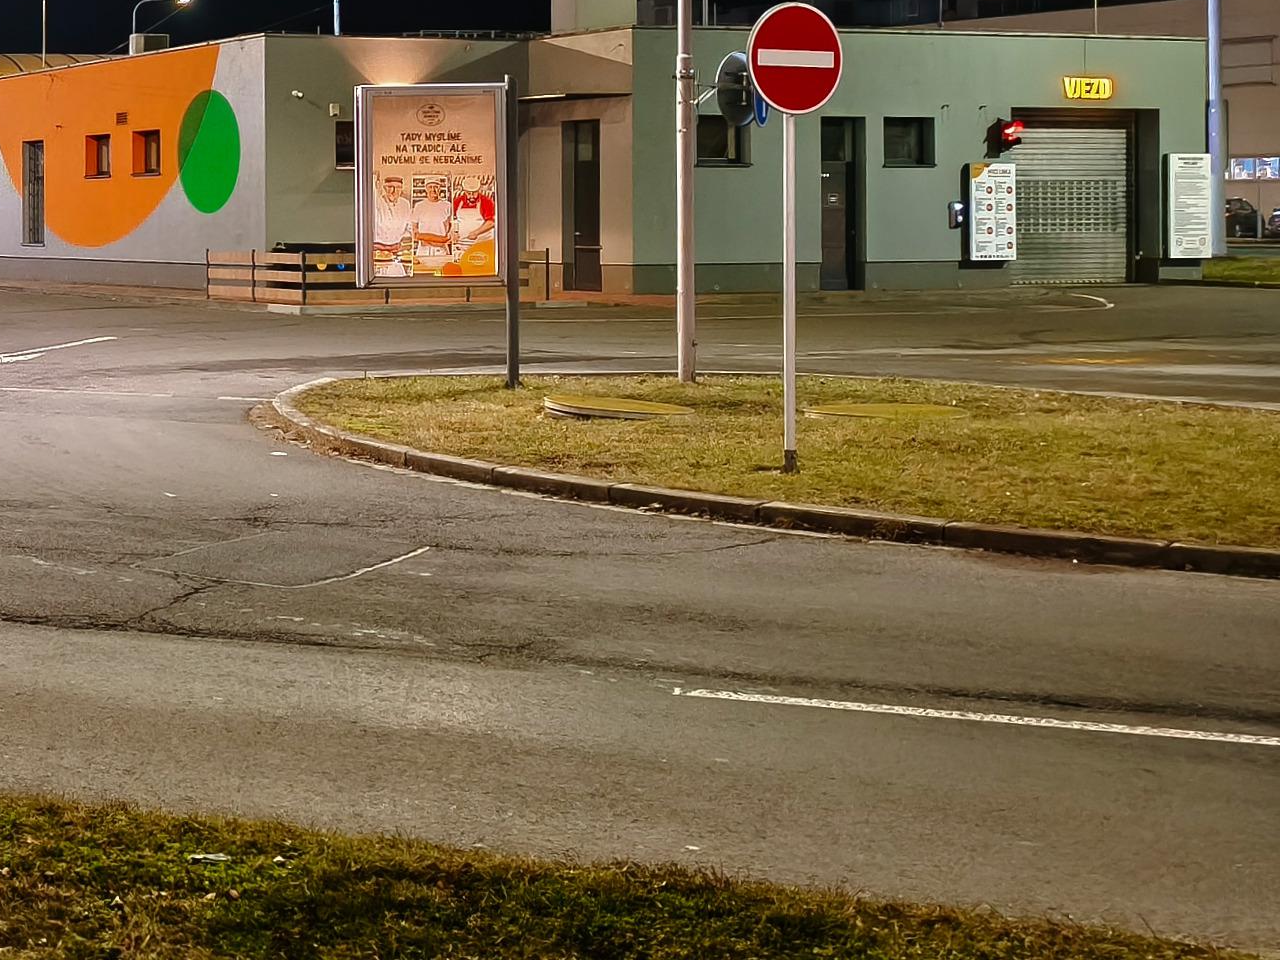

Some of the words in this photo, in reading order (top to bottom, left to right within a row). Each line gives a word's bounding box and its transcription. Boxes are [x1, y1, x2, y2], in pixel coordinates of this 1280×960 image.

[1064, 77, 1113, 99] VJEZD
[401, 132, 422, 141] TADY
[425, 131, 462, 141] MYSLÍME
[396, 144, 408, 153] NA
[450, 144, 467, 153] ALE
[382, 154, 416, 164] NOVÉMU
[419, 156, 431, 164] SE
